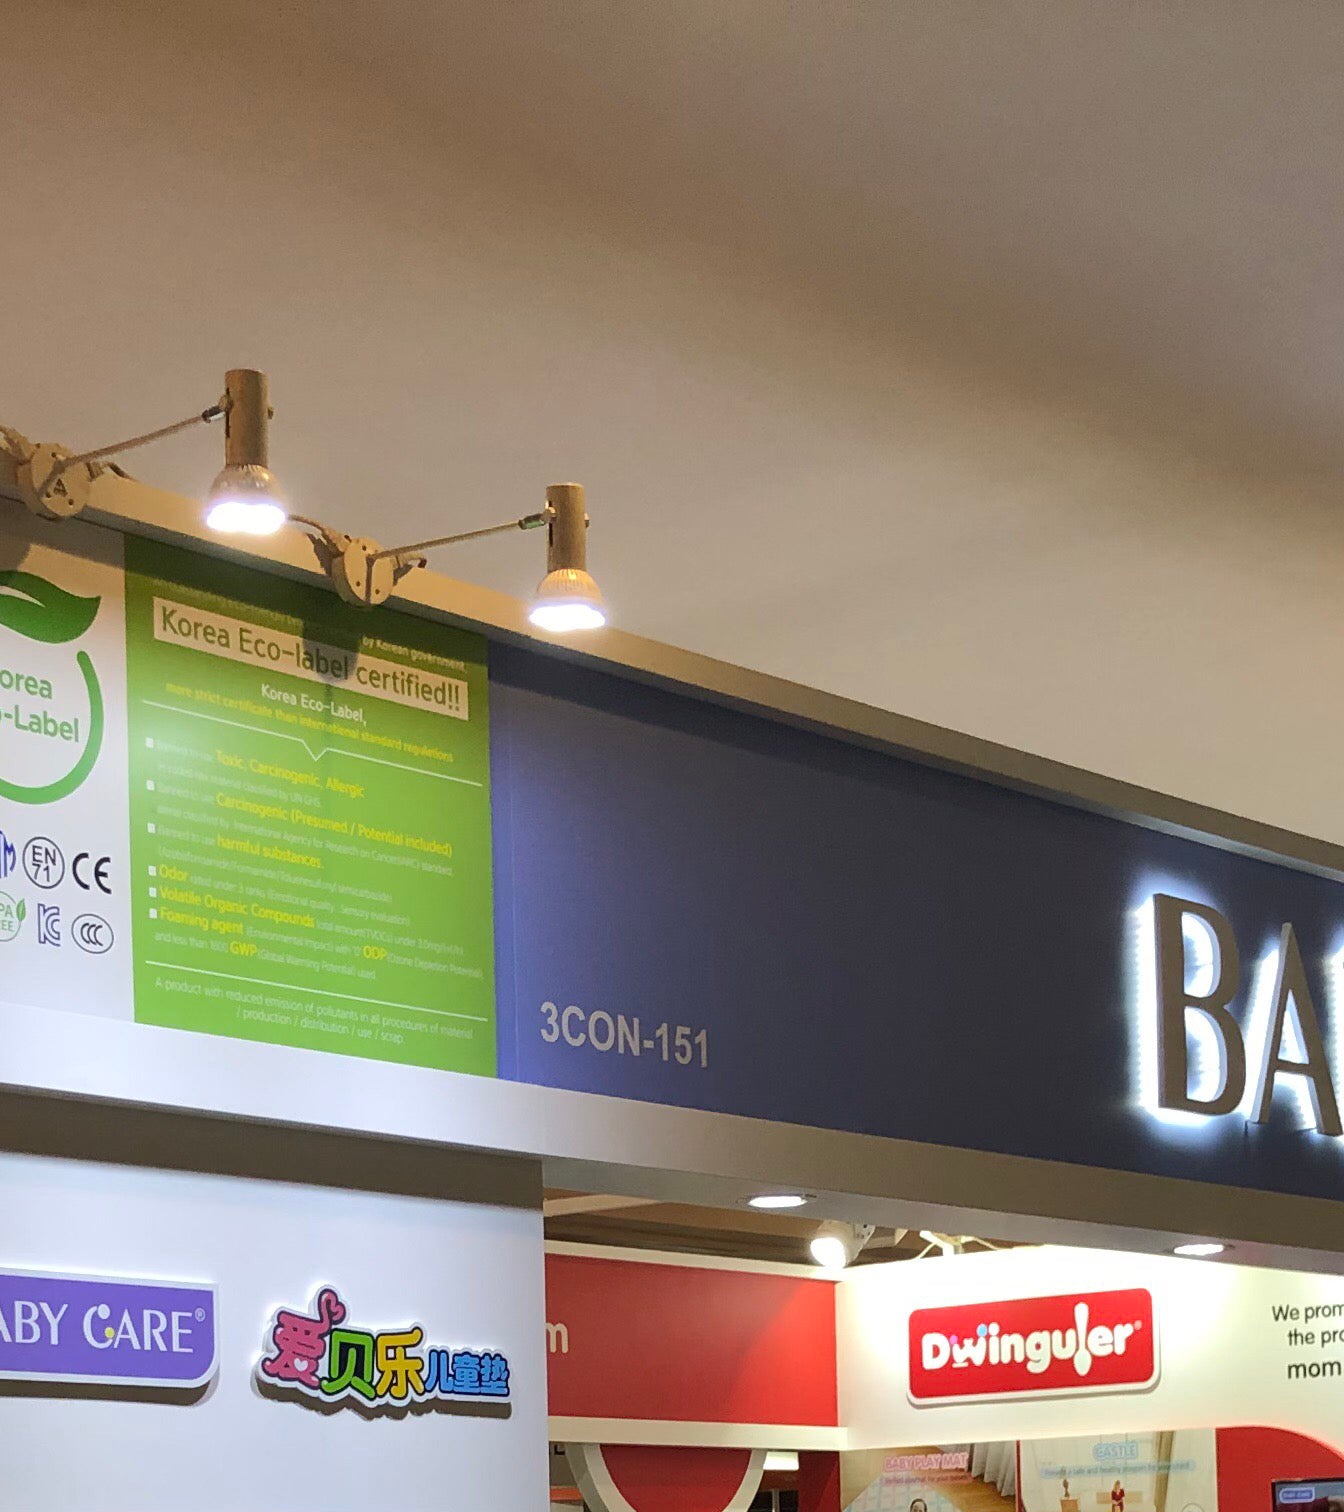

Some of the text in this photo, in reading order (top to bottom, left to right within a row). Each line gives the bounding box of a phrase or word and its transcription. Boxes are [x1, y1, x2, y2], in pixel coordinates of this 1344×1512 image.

[162, 604, 231, 648] Korea
[240, 626, 349, 680] Eco-label
[356, 662, 460, 711] certified!!
[261, 683, 367, 727] Korea Eco-Label,
[326, 777, 365, 799] Allergic
[216, 792, 288, 821] Carcinogenic
[291, 809, 348, 834] (Presumed
[358, 823, 404, 847] Potential
[406, 836, 453, 858] included)
[31, 844, 57, 866] EN
[32, 864, 51, 882] 71
[159, 863, 189, 882] Odor
[160, 885, 316, 929] Volatile Organic Compounds
[160, 906, 388, 960] Foaming agent ODP
[230, 940, 258, 957] GWP
[165, 979, 201, 996] product
[243, 1008, 292, 1026] production
[540, 1001, 709, 1068] 3CON-151
[1272, 1304, 1300, 1322] We
[83, 1303, 195, 1354] CARE
[1288, 1328, 1315, 1347] the
[921, 1302, 1134, 1377] Dwinguler
[1288, 1360, 1341, 1380] mom
[1094, 1443, 1137, 1459] CASTLE
[885, 1452, 968, 1472] BABY PLAY MAT
